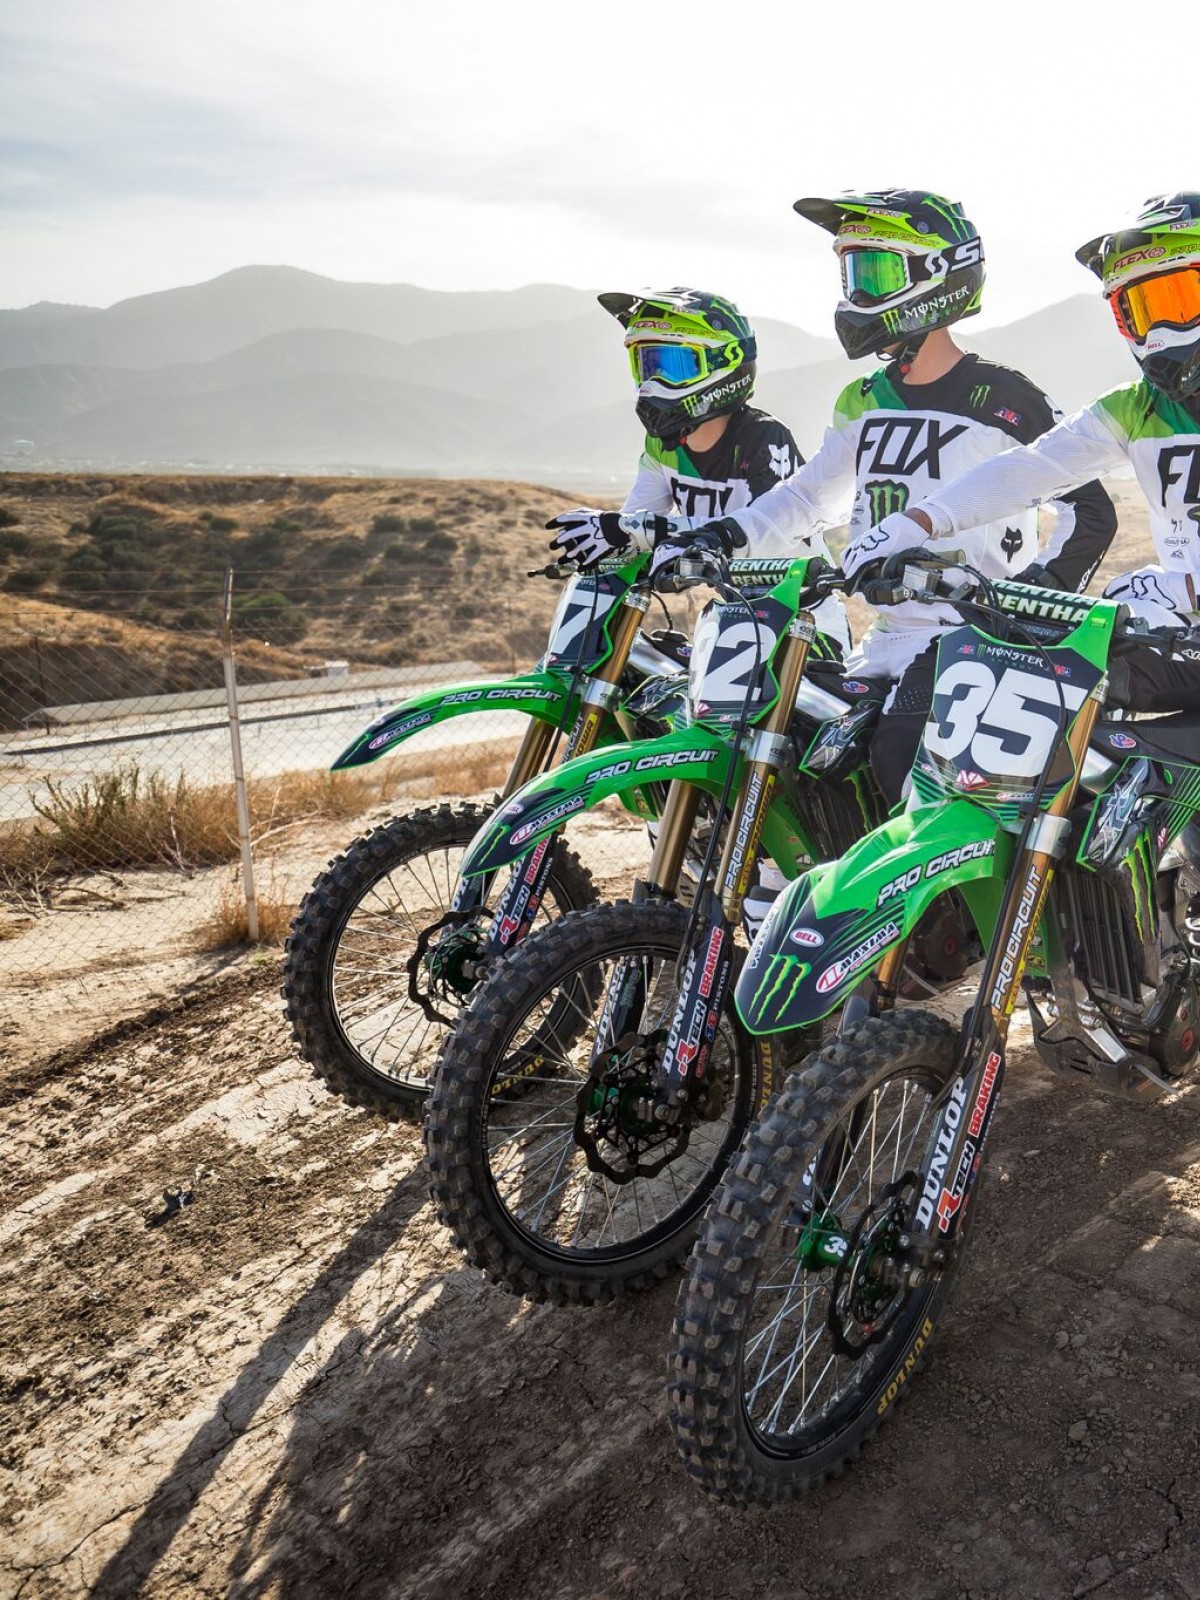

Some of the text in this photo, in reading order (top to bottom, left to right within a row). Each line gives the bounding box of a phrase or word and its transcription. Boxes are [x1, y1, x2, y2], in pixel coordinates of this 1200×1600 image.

[1113, 248, 1151, 272] FLEX
[904, 285, 970, 320] MONSTER
[702, 374, 752, 402] MONSTER
[856, 417, 970, 480] FOX
[729, 559, 792, 572] RENTHA
[731, 574, 784, 585] RENTH
[551, 589, 617, 655] 7
[983, 592, 1089, 622] ENTHA
[699, 621, 777, 701] 2
[985, 647, 1044, 668] MONSTER
[441, 688, 562, 704] PRO CIRCUIT
[924, 660, 1089, 778] 35
[585, 750, 720, 784] PRO CIRCUIT
[725, 772, 762, 891] PRO CIRCUIT
[523, 837, 548, 885] BRAKIN
[489, 855, 525, 941] DUNLO
[877, 868, 921, 907] PRO
[698, 926, 725, 998] BRAKING
[794, 931, 818, 944] BELL
[991, 961, 1015, 1011] PRO
[1008, 864, 1045, 964] CIRCUIT
[712, 960, 730, 1011] PISTONS
[661, 949, 698, 1076] DUNLOP
[967, 1051, 1001, 1138] BRAKING
[915, 1076, 968, 1231] DUNLOP
[877, 1317, 935, 1416] DUNLOP
